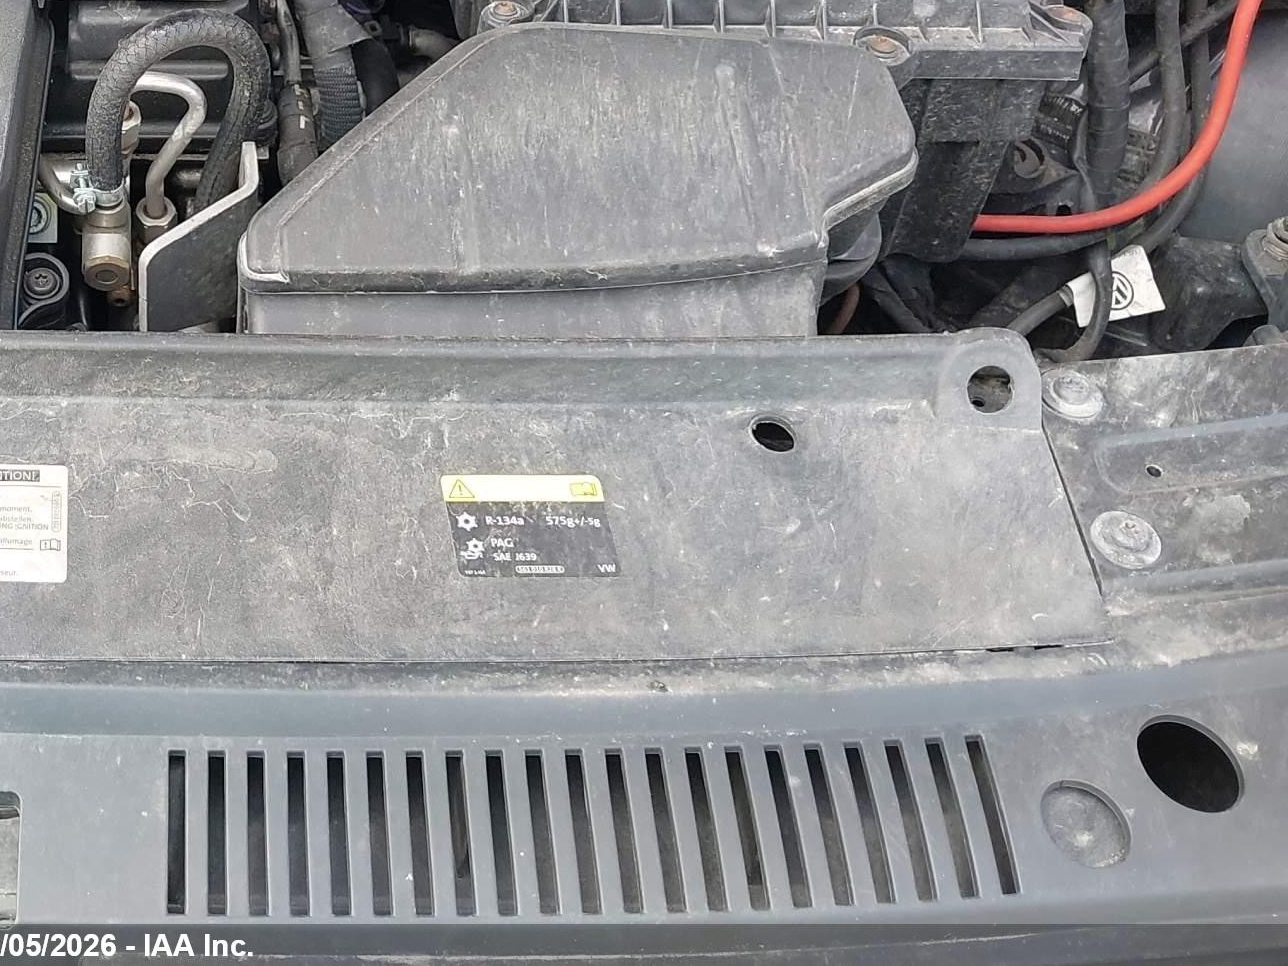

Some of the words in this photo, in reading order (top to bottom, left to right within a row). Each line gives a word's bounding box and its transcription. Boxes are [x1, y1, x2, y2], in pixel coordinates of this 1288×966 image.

[485, 515, 525, 525] R-134a
[491, 538, 515, 548] PAG
[493, 552, 512, 561] SAE
[598, 563, 616, 573] VW
